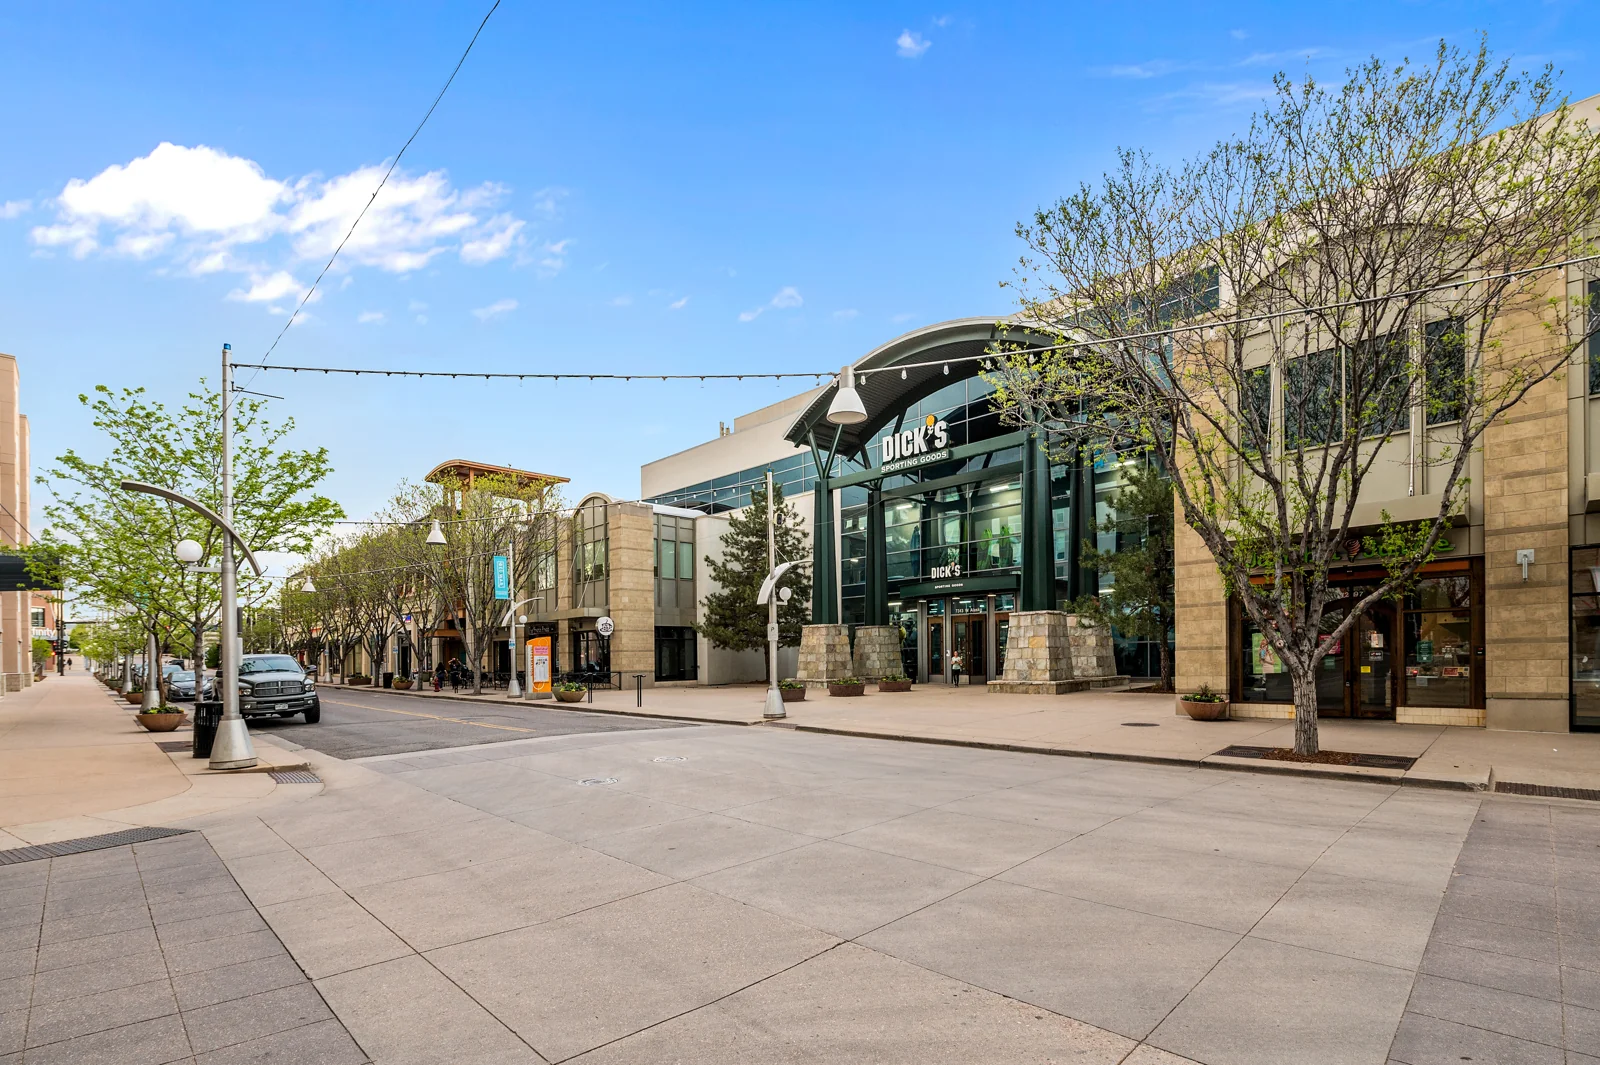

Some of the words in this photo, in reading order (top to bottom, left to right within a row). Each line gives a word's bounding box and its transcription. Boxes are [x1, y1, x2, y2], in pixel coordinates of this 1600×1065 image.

[882, 420, 947, 463] DICK'S
[881, 458, 918, 473] SPORTING
[920, 451, 947, 464] GOODS
[931, 564, 961, 579] DICK'S
